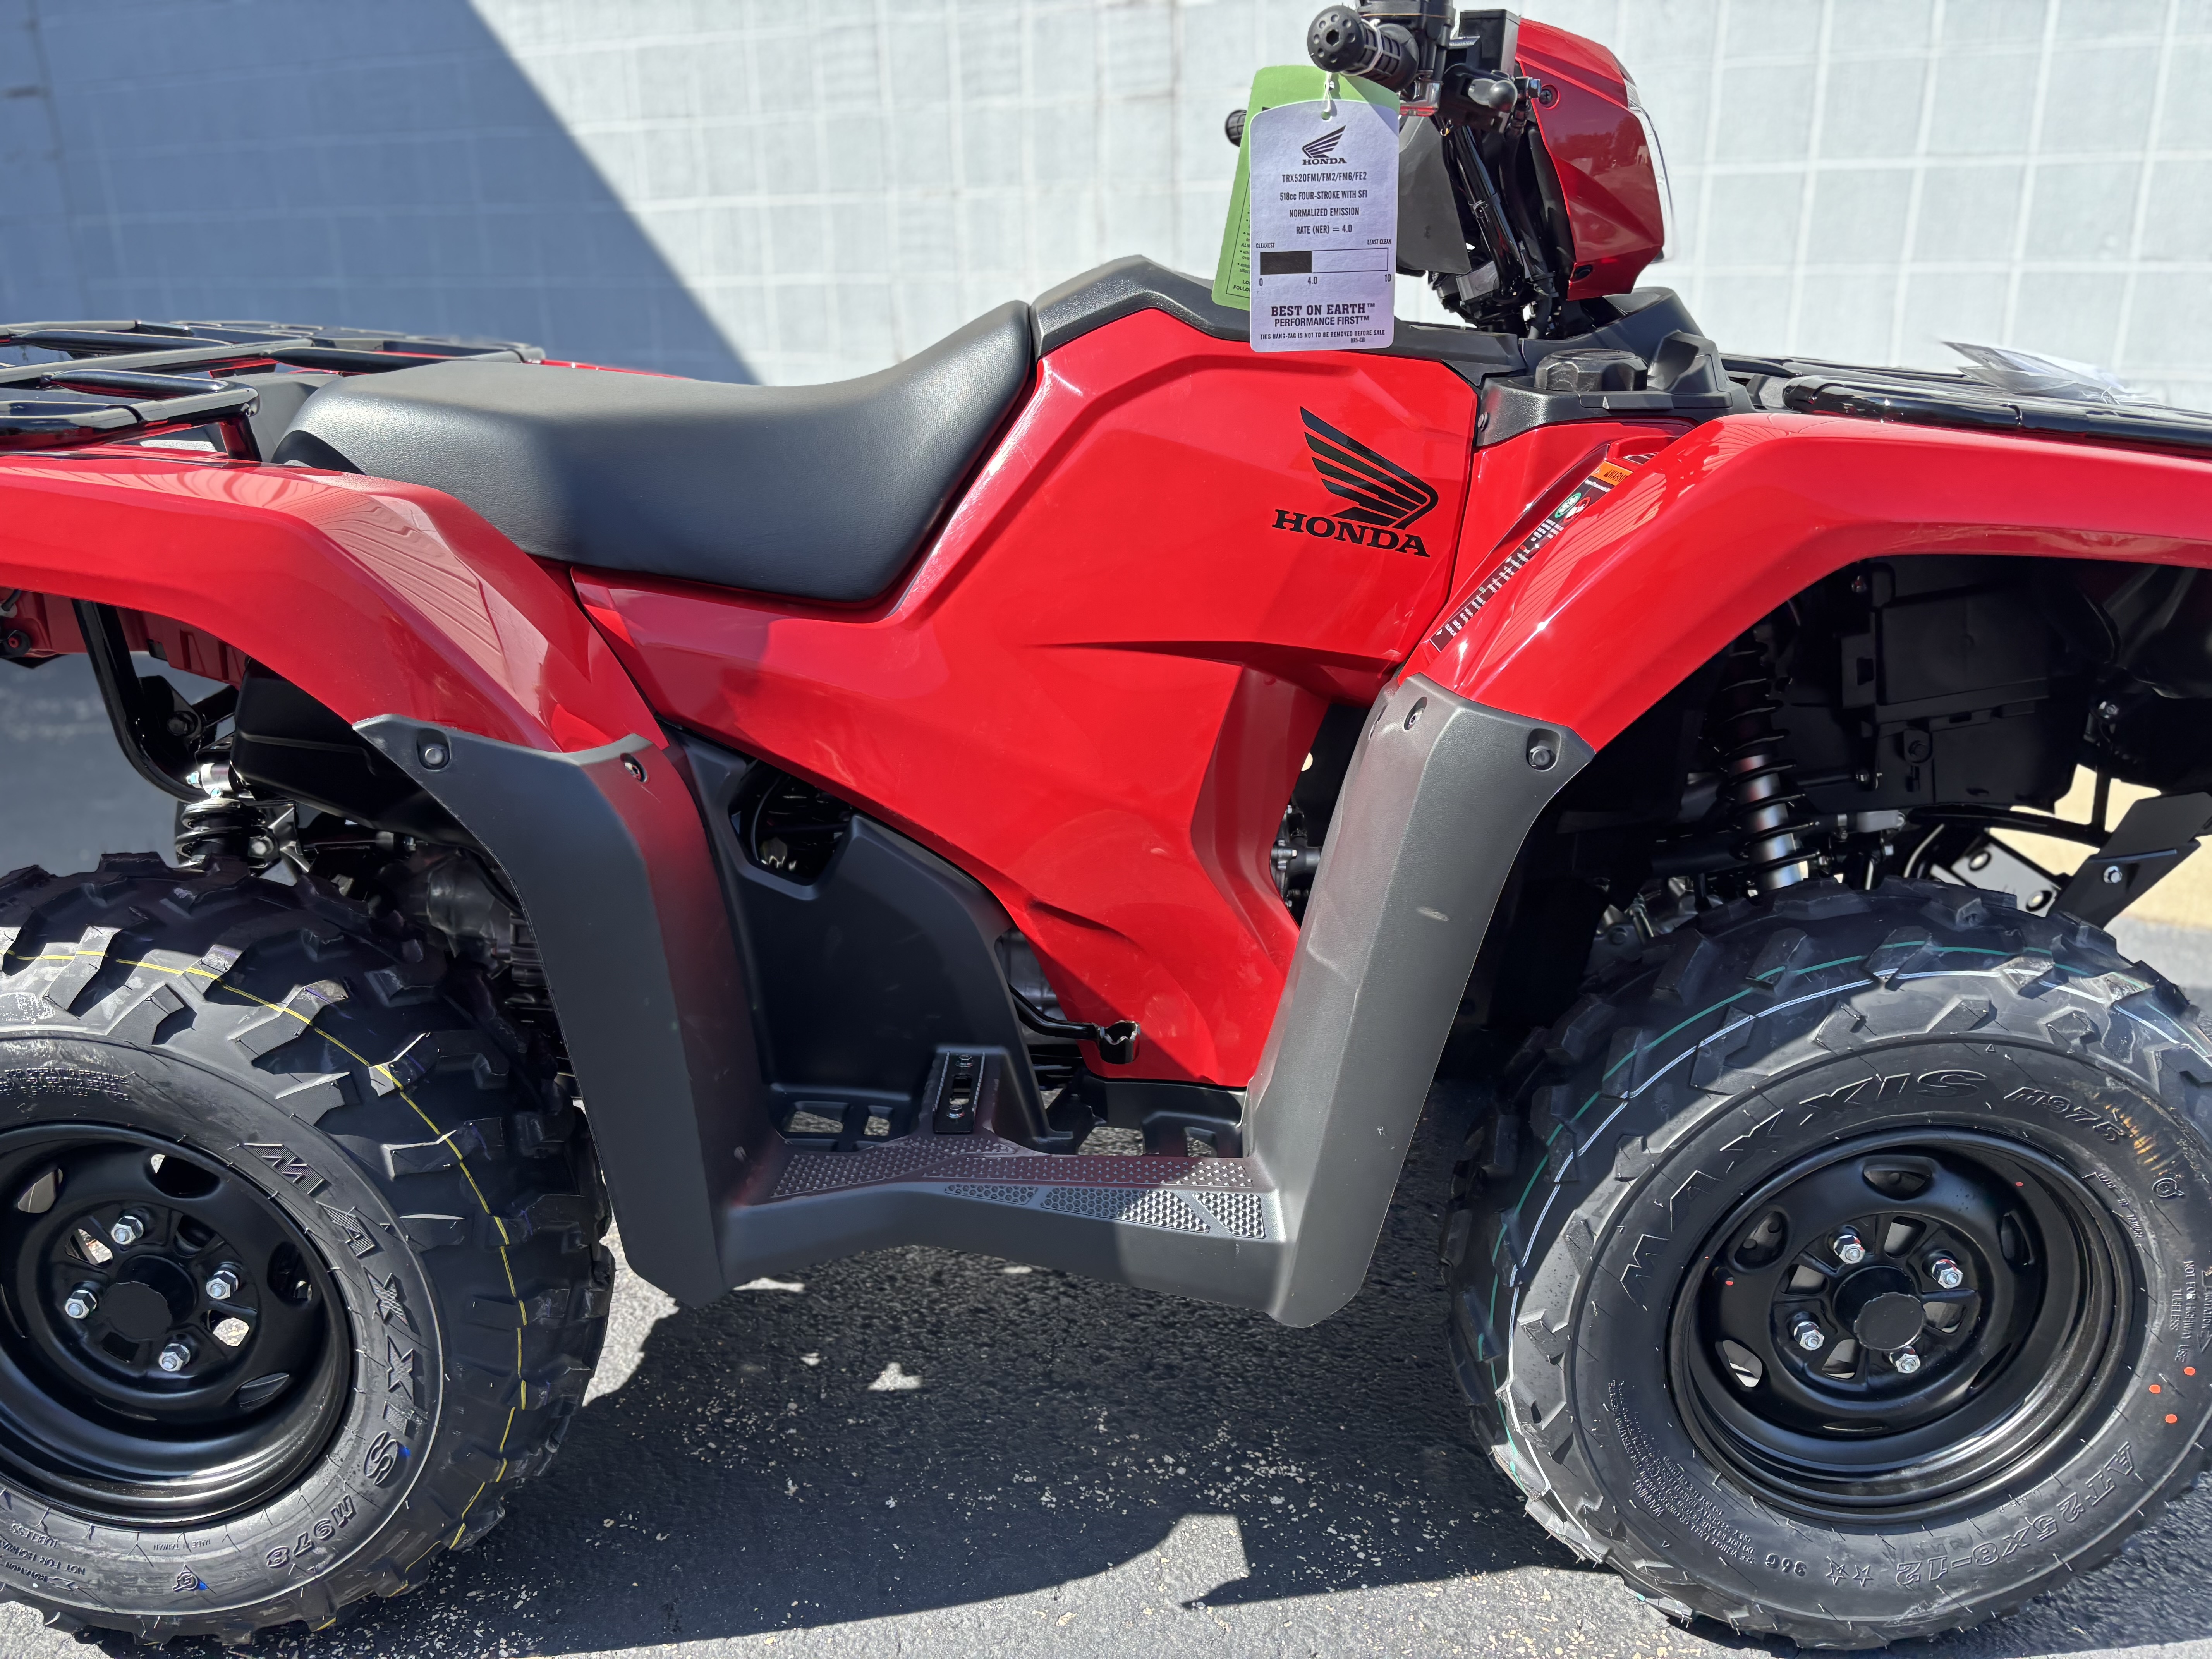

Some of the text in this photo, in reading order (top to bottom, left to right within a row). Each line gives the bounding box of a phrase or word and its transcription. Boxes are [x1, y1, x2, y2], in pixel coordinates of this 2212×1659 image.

[1282, 172, 1367, 182] TRX520FM1/FM2/FM6/FE2
[1280, 190, 1367, 201] 518cc FOUR-STROKE WITH SFI
[1289, 207, 1359, 218] NORMALIZED EMISSION
[1296, 226, 1310, 234] RATE
[1312, 225, 1330, 234] (NER)
[1259, 278, 1263, 286] 0
[1307, 276, 1317, 285] 4.0
[1385, 274, 1391, 282] 10
[1271, 306, 1302, 316] BEST
[1307, 305, 1322, 316] ON
[1275, 317, 1335, 327] PERFORMANCE
[1272, 509, 1430, 557] HONDA
[2183, 1261, 2195, 1278] NOT
[244, 1143, 414, 1486] MAXXIS
[2169, 1289, 2183, 1331] TUBELESS
[2181, 1303, 2197, 1339] HIGHWAY
[2175, 1345, 2190, 1362] USE
[1635, 1480, 1664, 1517] WARNING
[1700, 1496, 1712, 1509] NOT
[1712, 1506, 1723, 1515] DO
[1680, 1515, 1689, 1525] OR
[266, 1493, 357, 1568] M978
[1733, 1530, 1751, 1542] ONLY
[1711, 1539, 1737, 1558] VEHICLE
[1726, 1537, 1742, 1549] NOT
[1743, 1545, 1753, 1554] DO
[66, 1563, 86, 1575] NOT
